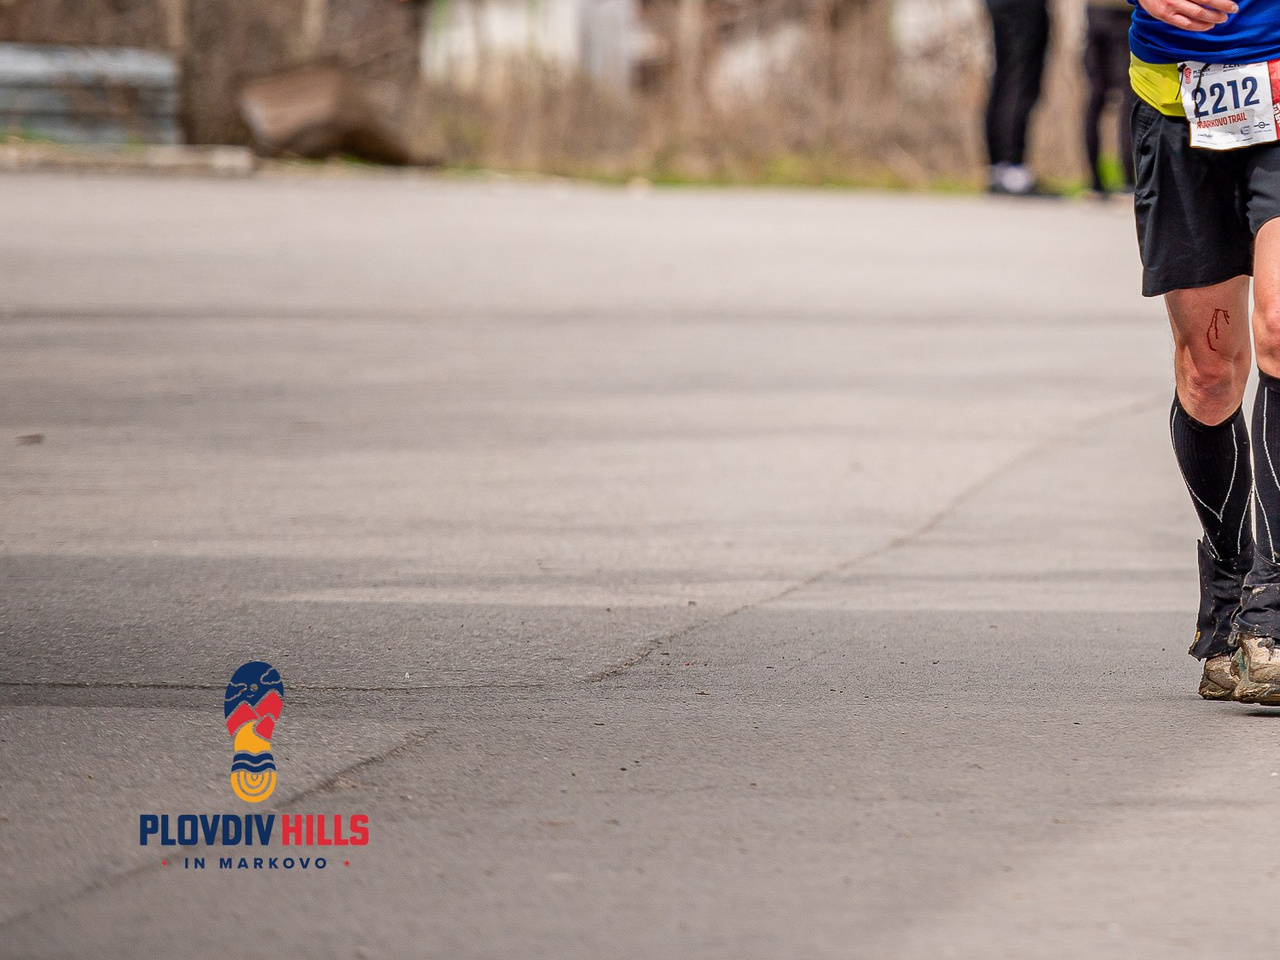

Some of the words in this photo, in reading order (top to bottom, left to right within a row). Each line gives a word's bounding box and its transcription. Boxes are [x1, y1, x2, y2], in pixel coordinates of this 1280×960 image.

[1192, 76, 1260, 118] 2212
[1196, 116, 1228, 129] MARKOVO
[1227, 112, 1248, 125] TRAIL
